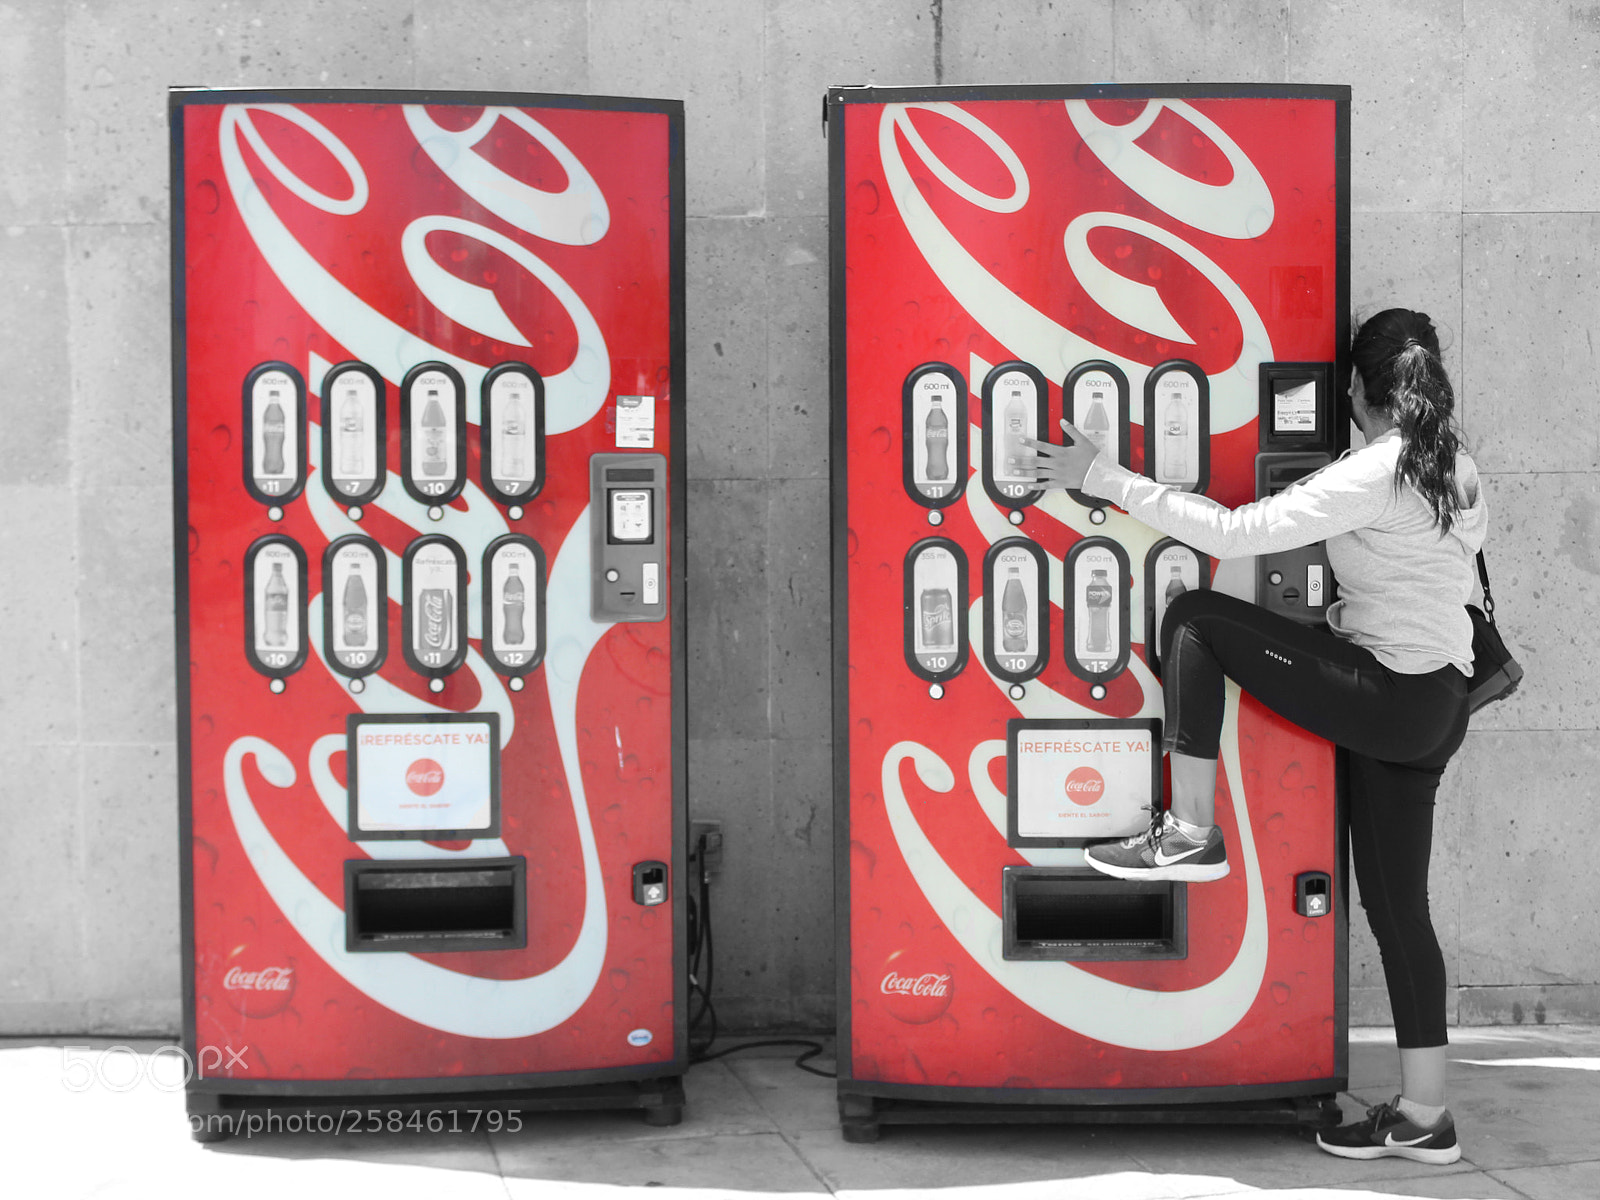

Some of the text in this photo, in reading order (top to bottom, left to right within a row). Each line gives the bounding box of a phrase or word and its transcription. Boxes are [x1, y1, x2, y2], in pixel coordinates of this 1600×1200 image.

[941, 382, 949, 390] ml
[1021, 378, 1030, 386] ml
[1163, 380, 1189, 388] 600 ml
[927, 486, 943, 497] $11
[1004, 485, 1024, 496] $10
[921, 552, 946, 560] 355 ml
[1018, 554, 1027, 562] ml
[1103, 554, 1112, 562] ml
[1180, 553, 1188, 561] ml
[927, 657, 947, 668] $10
[1005, 659, 1026, 670] $10
[1021, 739, 1149, 753] ¡REFRÉSCATE YA!
